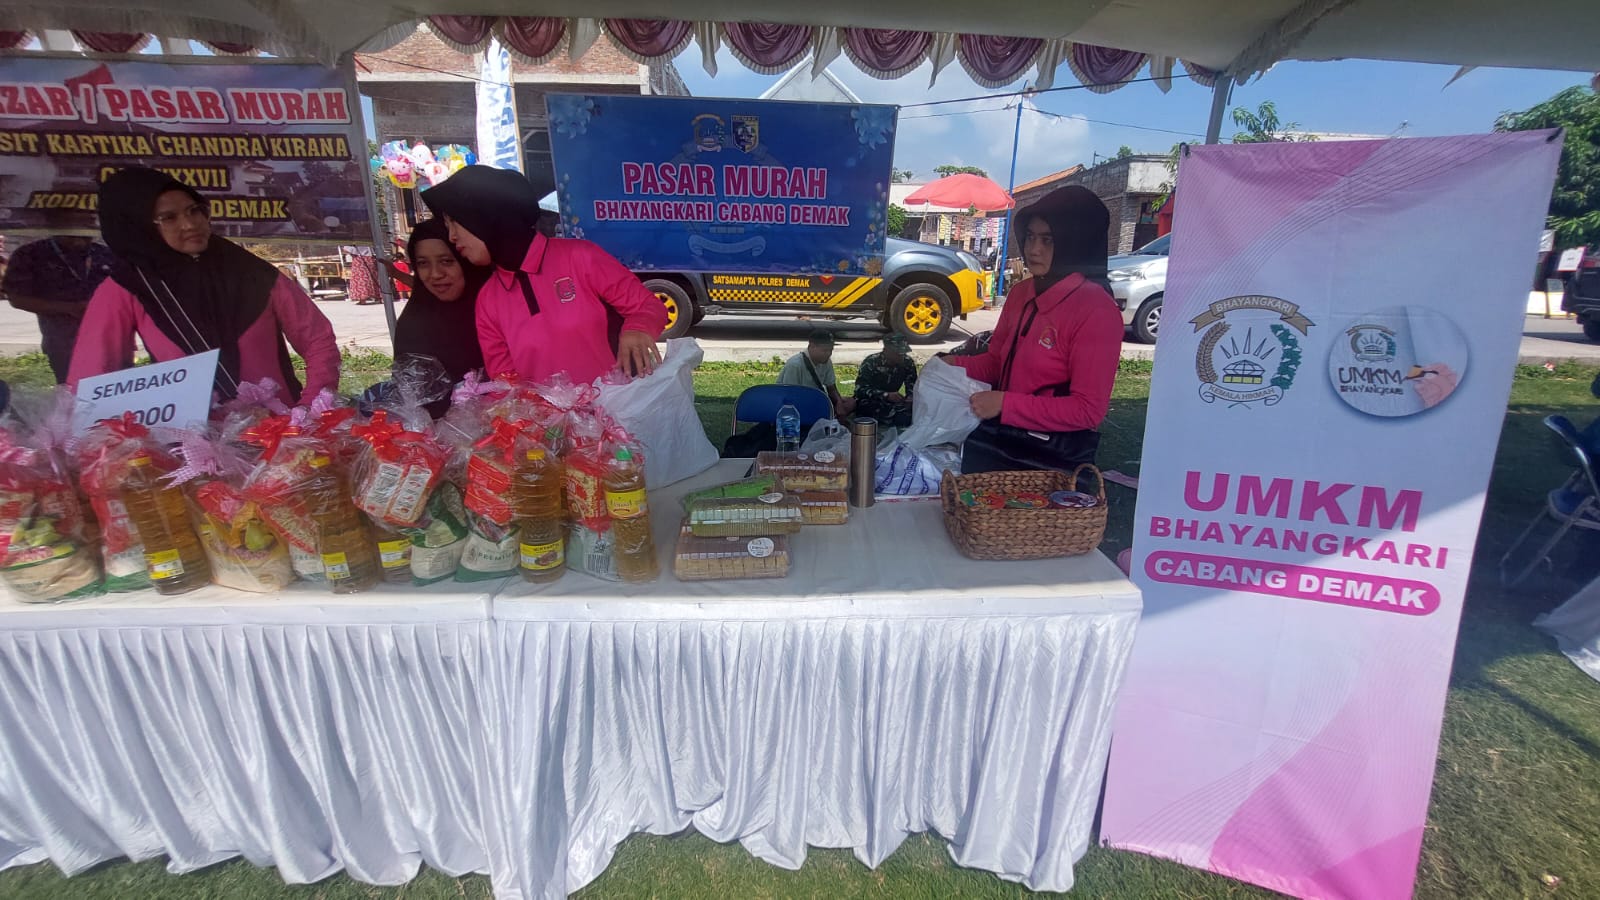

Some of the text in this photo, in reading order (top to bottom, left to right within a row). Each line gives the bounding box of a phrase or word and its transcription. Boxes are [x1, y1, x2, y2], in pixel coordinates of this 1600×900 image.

[0, 84, 75, 116] ZAR
[102, 87, 225, 120] PASAR
[231, 91, 347, 120] MURAH
[47, 134, 151, 156] KARTIKA
[160, 136, 265, 157] CHANDRA
[269, 138, 349, 157] KIRANA
[623, 162, 828, 199] PASAR MURAH
[211, 200, 287, 218] DEMAK
[594, 201, 850, 226] BHAYANGKARI CABANG DEMAK
[757, 276, 783, 287] POLRES
[786, 278, 810, 288] DEMAK
[1215, 298, 1294, 313] BHAYANGKARI
[92, 368, 187, 400] SEMBAKO
[1338, 367, 1403, 385] UMKM
[1184, 471, 1422, 532] UMKM
[1150, 516, 1449, 569] BHAYANGKARI
[1154, 558, 1426, 609] CABANG DEMAK
